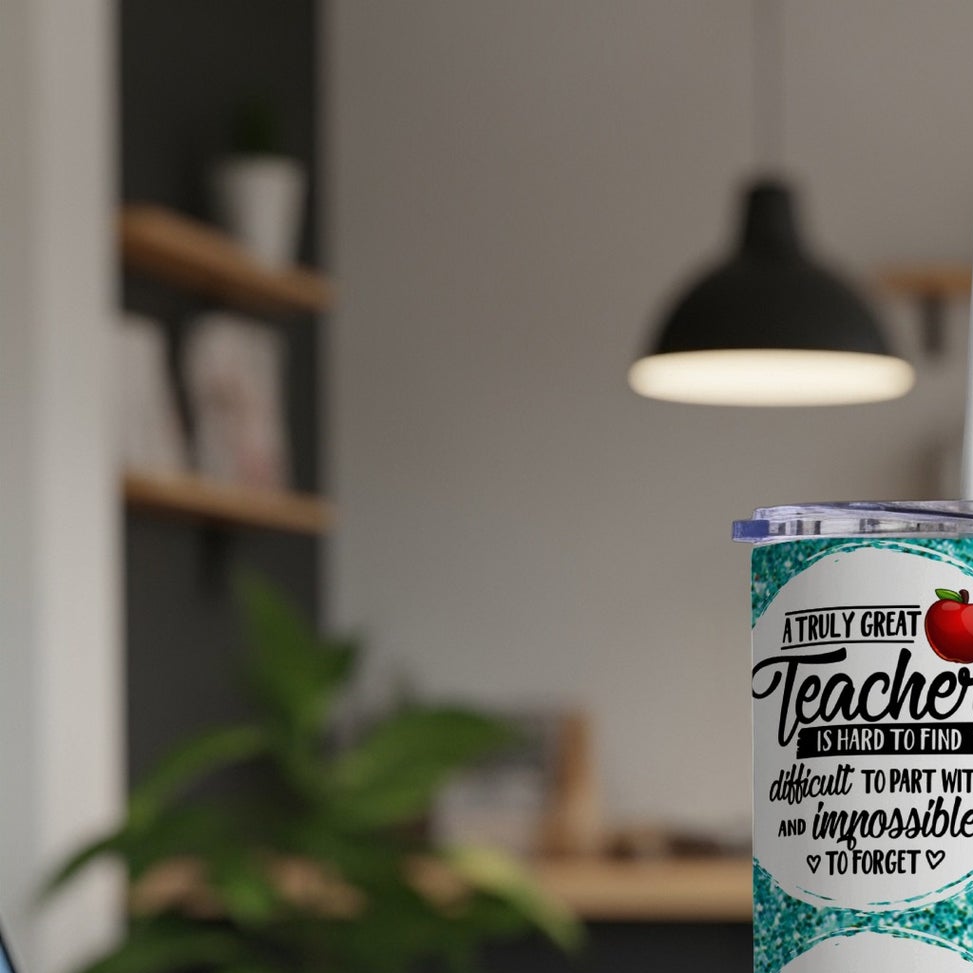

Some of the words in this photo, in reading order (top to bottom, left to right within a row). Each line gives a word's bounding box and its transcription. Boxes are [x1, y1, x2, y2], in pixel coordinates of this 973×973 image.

[783, 618, 792, 643] A
[796, 611, 855, 641] TRULY
[861, 611, 921, 638] GREAT
[817, 730, 832, 751] IS
[837, 729, 883, 751] HARD
[889, 729, 915, 750] TO
[920, 729, 961, 750] FIND
[769, 764, 855, 802] difficult
[861, 770, 886, 793] TO
[890, 769, 937, 793] PART
[778, 819, 806, 836] AND
[826, 851, 848, 875] TO
[852, 849, 921, 875] FORGET
